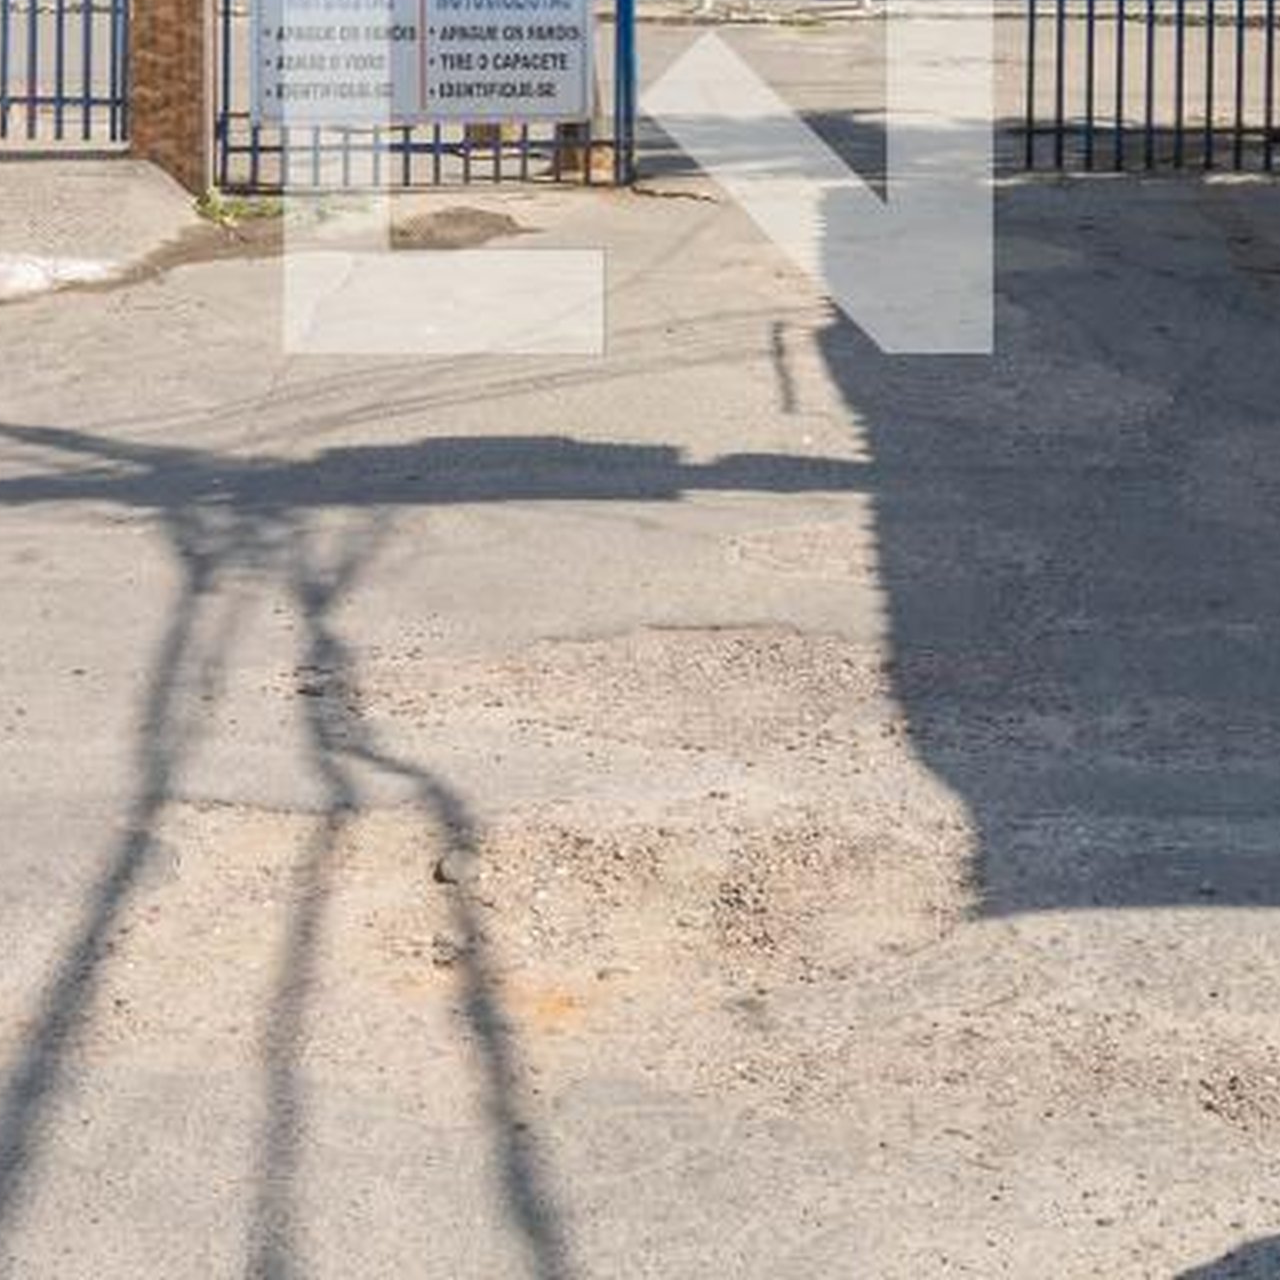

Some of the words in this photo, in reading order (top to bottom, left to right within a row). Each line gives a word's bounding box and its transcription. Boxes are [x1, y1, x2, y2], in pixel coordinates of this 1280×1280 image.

[439, 52, 473, 71] TIRE
[477, 52, 489, 71] O
[492, 52, 569, 71] CAPACETE
